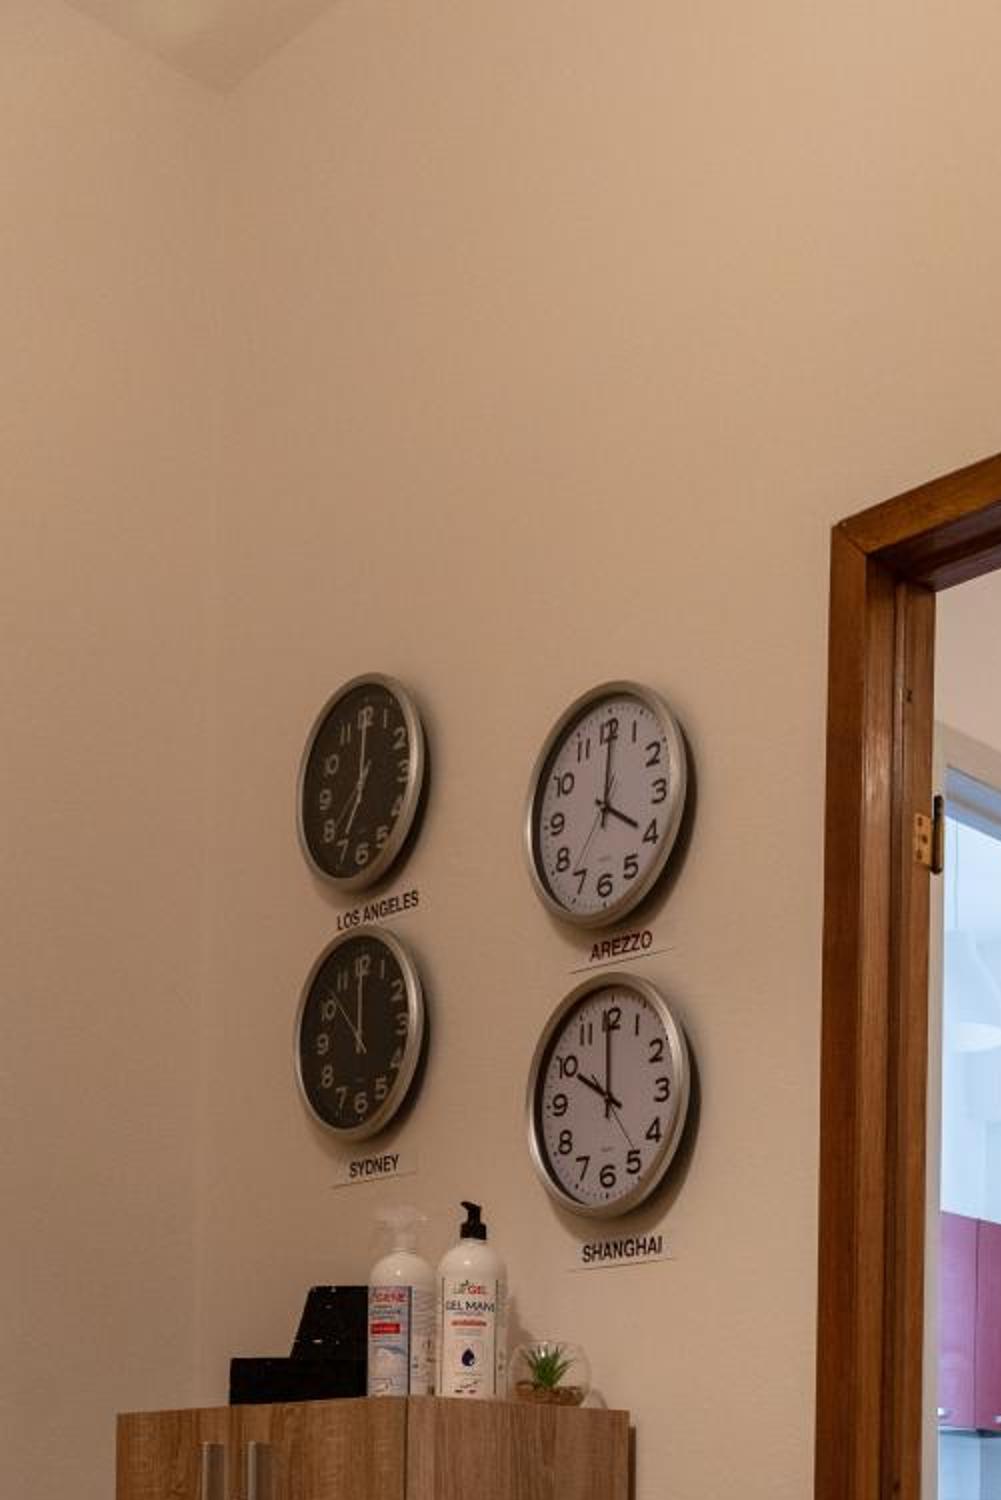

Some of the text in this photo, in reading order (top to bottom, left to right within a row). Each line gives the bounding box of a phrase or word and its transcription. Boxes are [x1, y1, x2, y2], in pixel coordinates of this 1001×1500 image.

[600, 718, 618, 744] 12
[577, 738, 591, 763] 11
[645, 741, 661, 767] 2
[554, 771, 575, 797] 10
[651, 778, 667, 804] 3
[550, 812, 565, 836] 9
[642, 818, 659, 845] 4
[555, 847, 570, 873] 8
[623, 854, 639, 880] 5
[572, 869, 588, 895] 7
[596, 873, 613, 898] 6
[337, 890, 418, 930] LOS ANGELES
[589, 930, 653, 962] AREZZO
[602, 1007, 621, 1032] 12
[579, 1022, 593, 1046] 11
[648, 1039, 664, 1063] 2
[556, 1055, 578, 1079] 10
[654, 1077, 670, 1102] 3
[552, 1094, 568, 1117] 9
[645, 1117, 662, 1142] 4
[558, 1130, 573, 1155] 8
[350, 1154, 399, 1178] SYDNEY
[575, 1156, 590, 1181] 7
[626, 1150, 641, 1175] 5
[599, 1165, 616, 1188] 6
[582, 1236, 662, 1263] SHANGHAI
